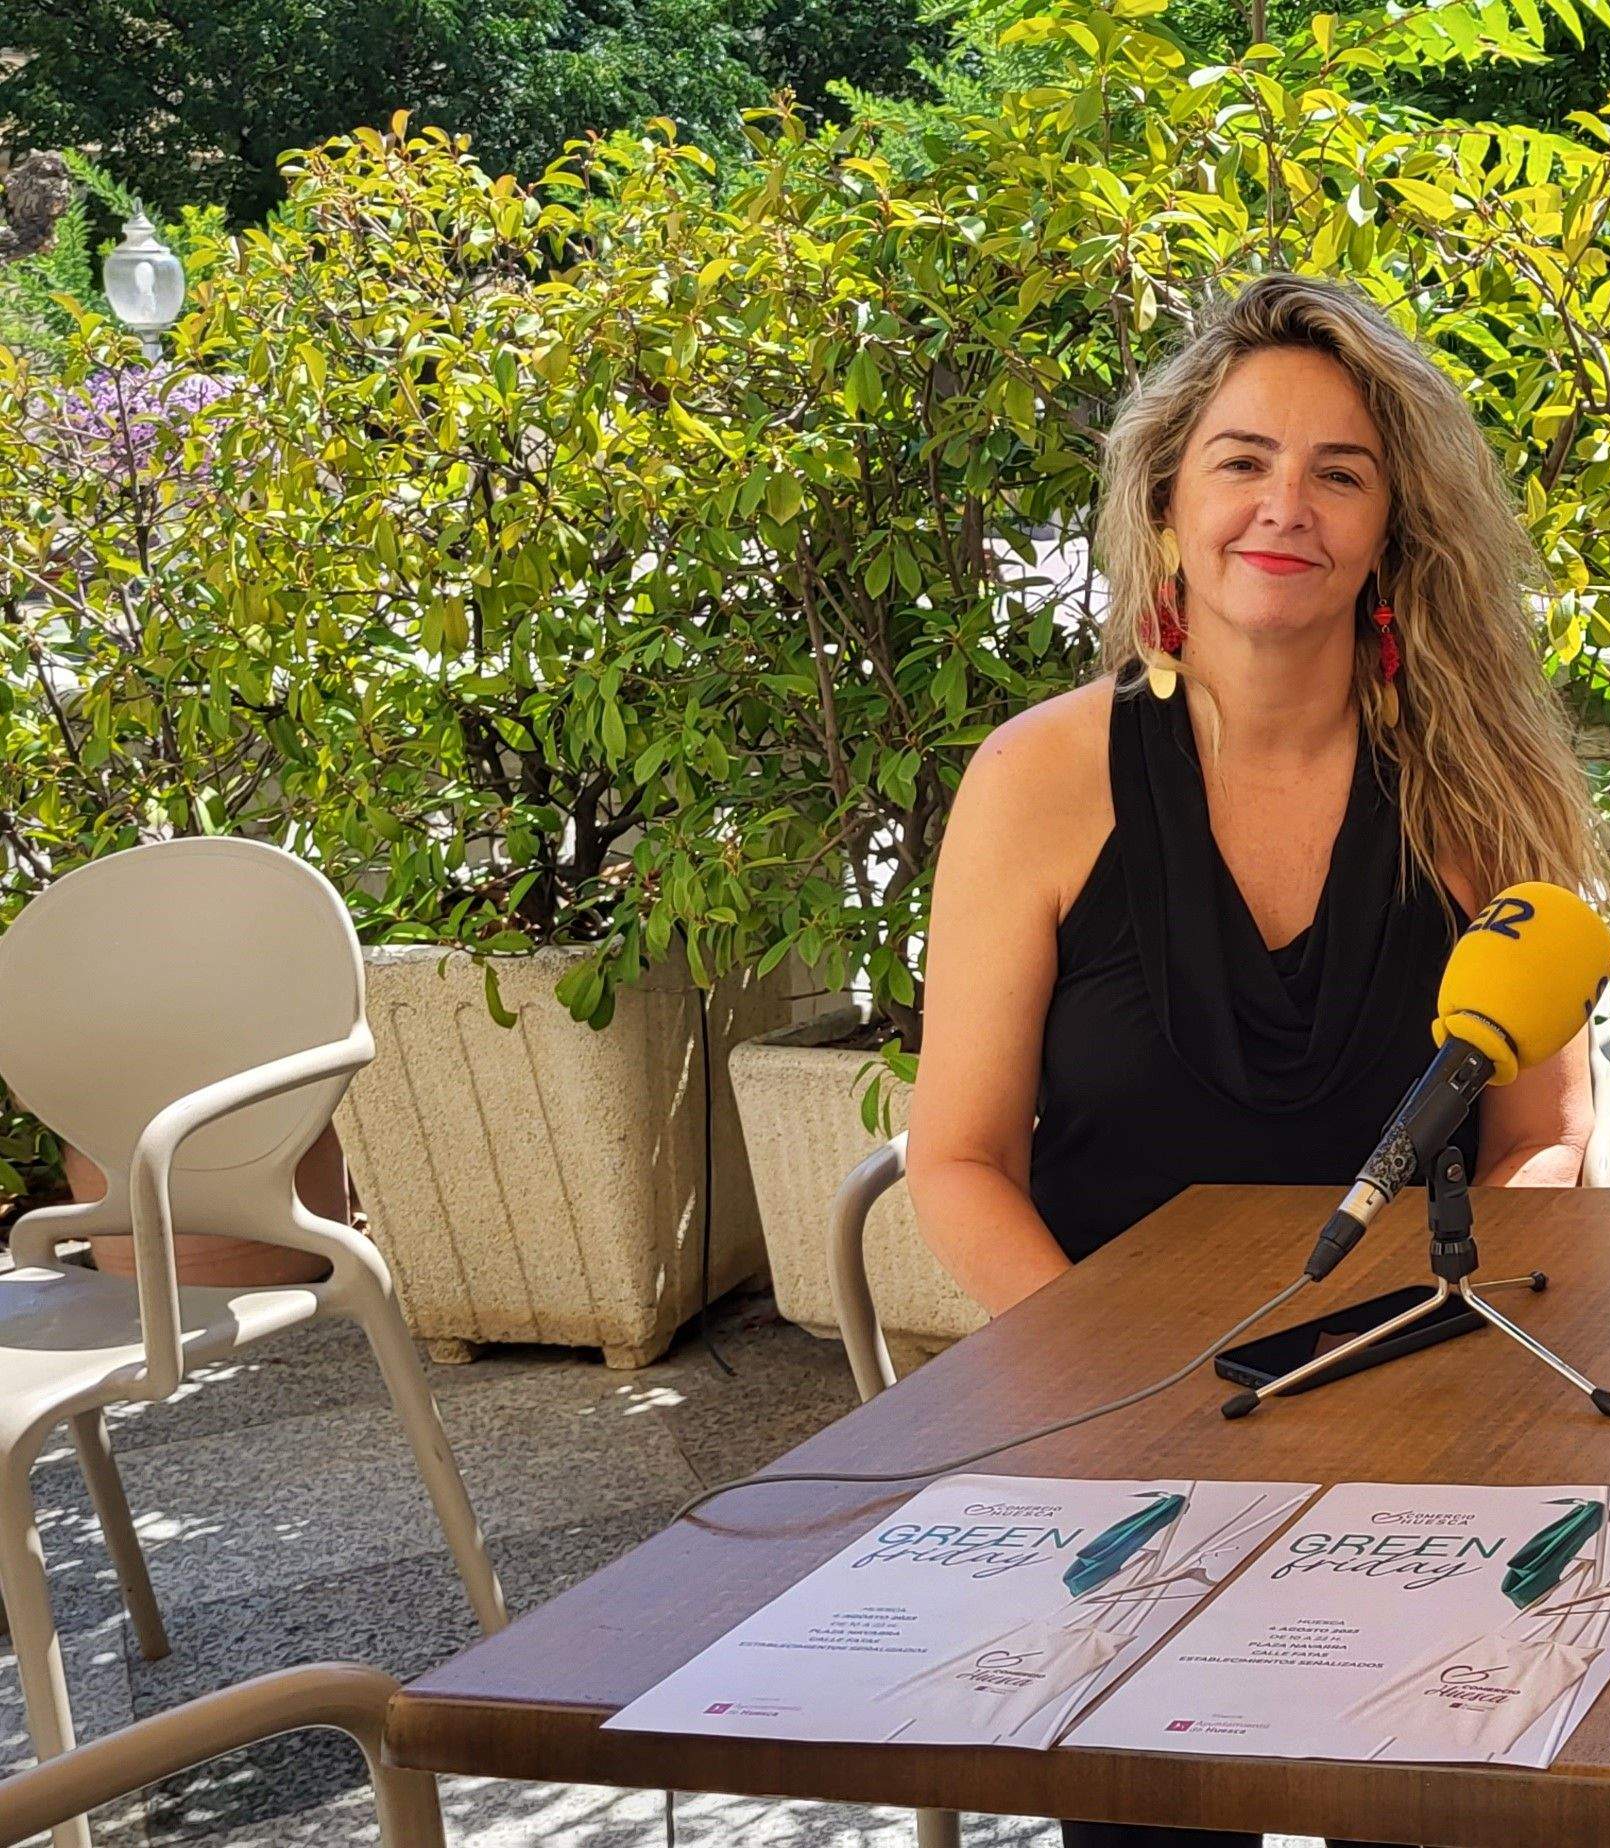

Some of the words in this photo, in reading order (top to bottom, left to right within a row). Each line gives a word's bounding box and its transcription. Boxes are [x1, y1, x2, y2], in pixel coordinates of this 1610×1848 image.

[878, 1524, 1084, 1549] GREEN
[1289, 1533, 1508, 1559] GREEN
[852, 1534, 1053, 1579] friday
[1270, 1546, 1483, 1590] friday
[1179, 1655, 1296, 1664] ESTABLECIMIENTOS
[1424, 1684, 1510, 1704] Huesca
[1205, 1727, 1247, 1735] Huesca
